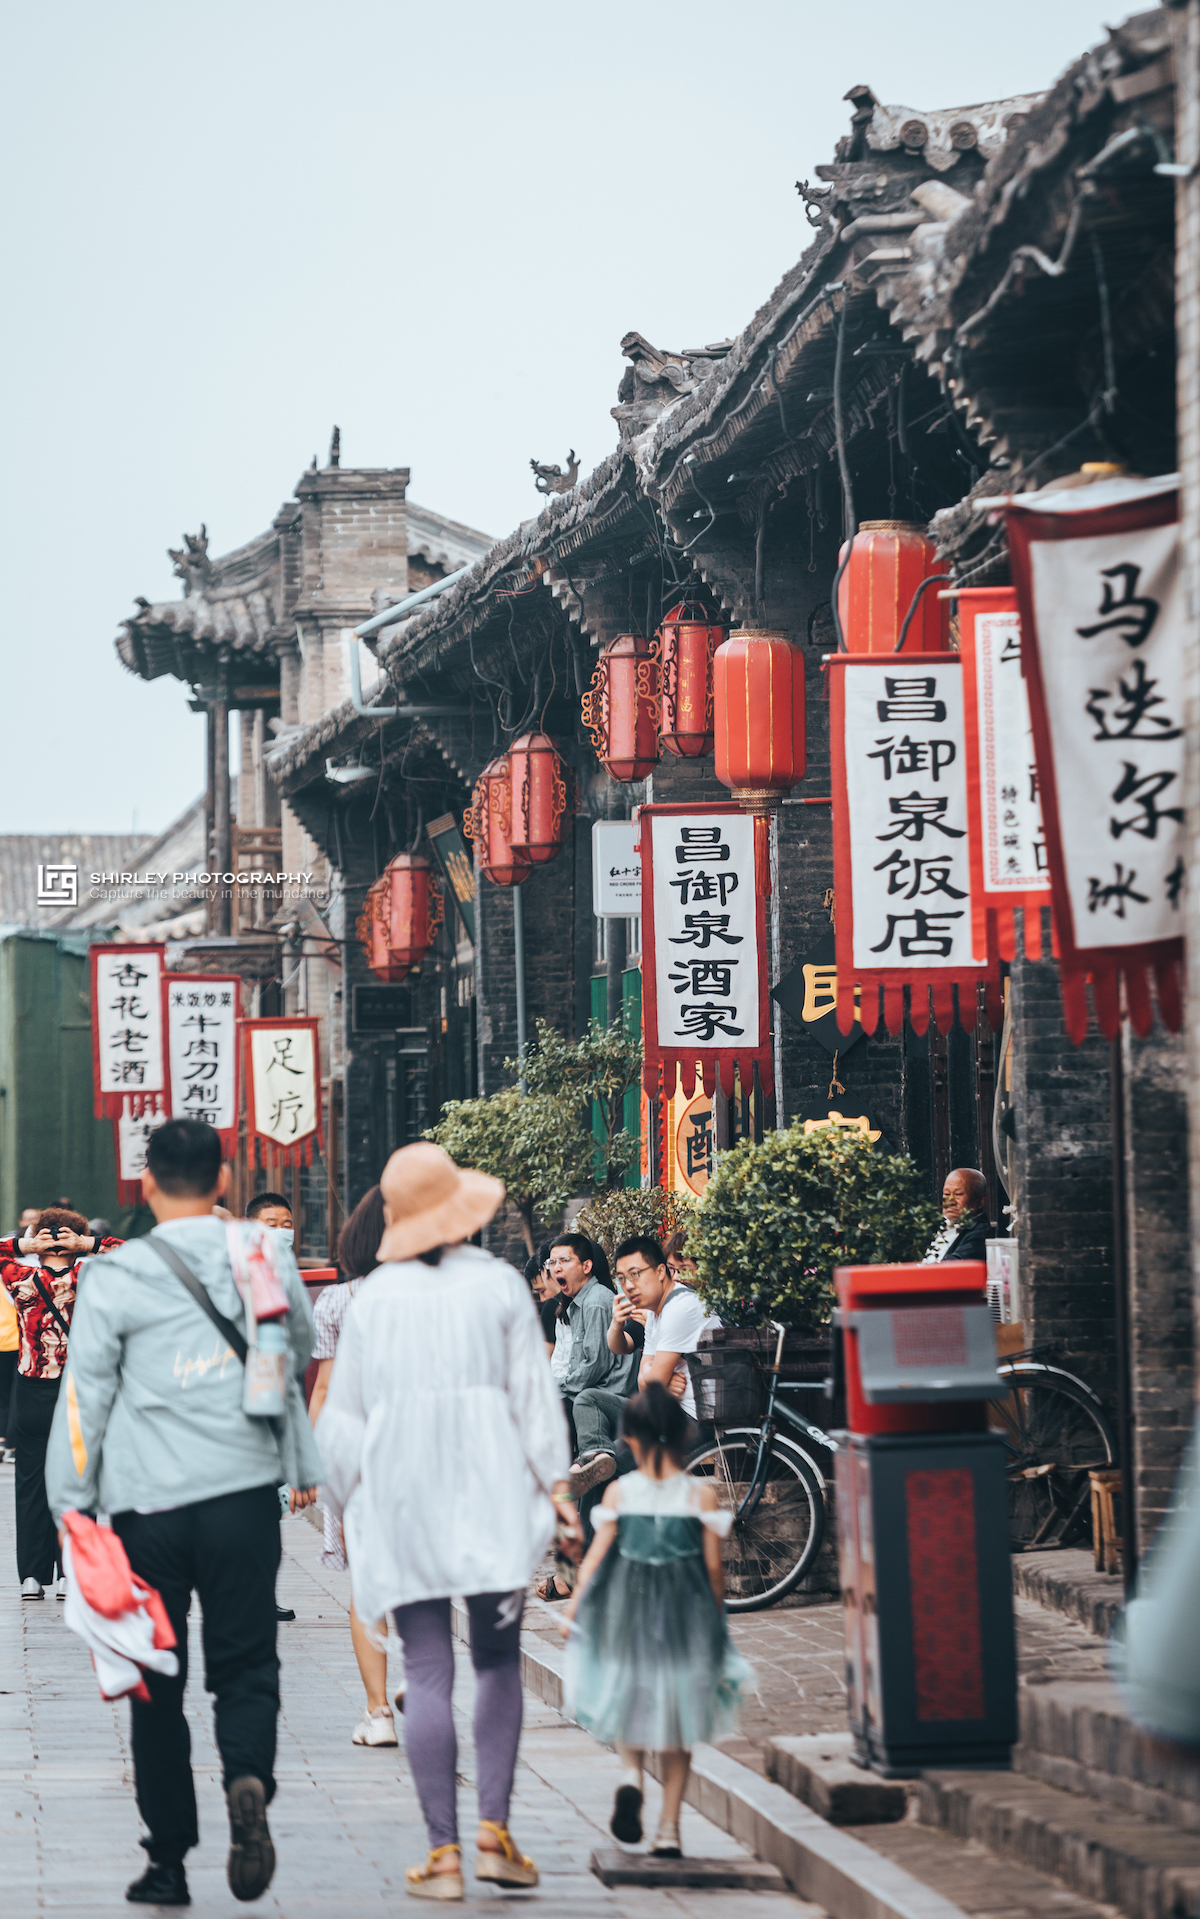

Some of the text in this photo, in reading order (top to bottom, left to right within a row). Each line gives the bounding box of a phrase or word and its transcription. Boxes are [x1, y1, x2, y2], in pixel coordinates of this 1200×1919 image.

[1076, 562, 1184, 840] 马迭尔
[866, 676, 969, 958] 昌御泉饭店
[667, 826, 745, 1041] 昌御泉酒家
[110, 963, 149, 1084] 杏花老酒
[172, 991, 233, 1007] 米饭炒菜
[181, 1014, 222, 1124] 牛肉刀削面
[265, 1037, 304, 1134] 足疗
